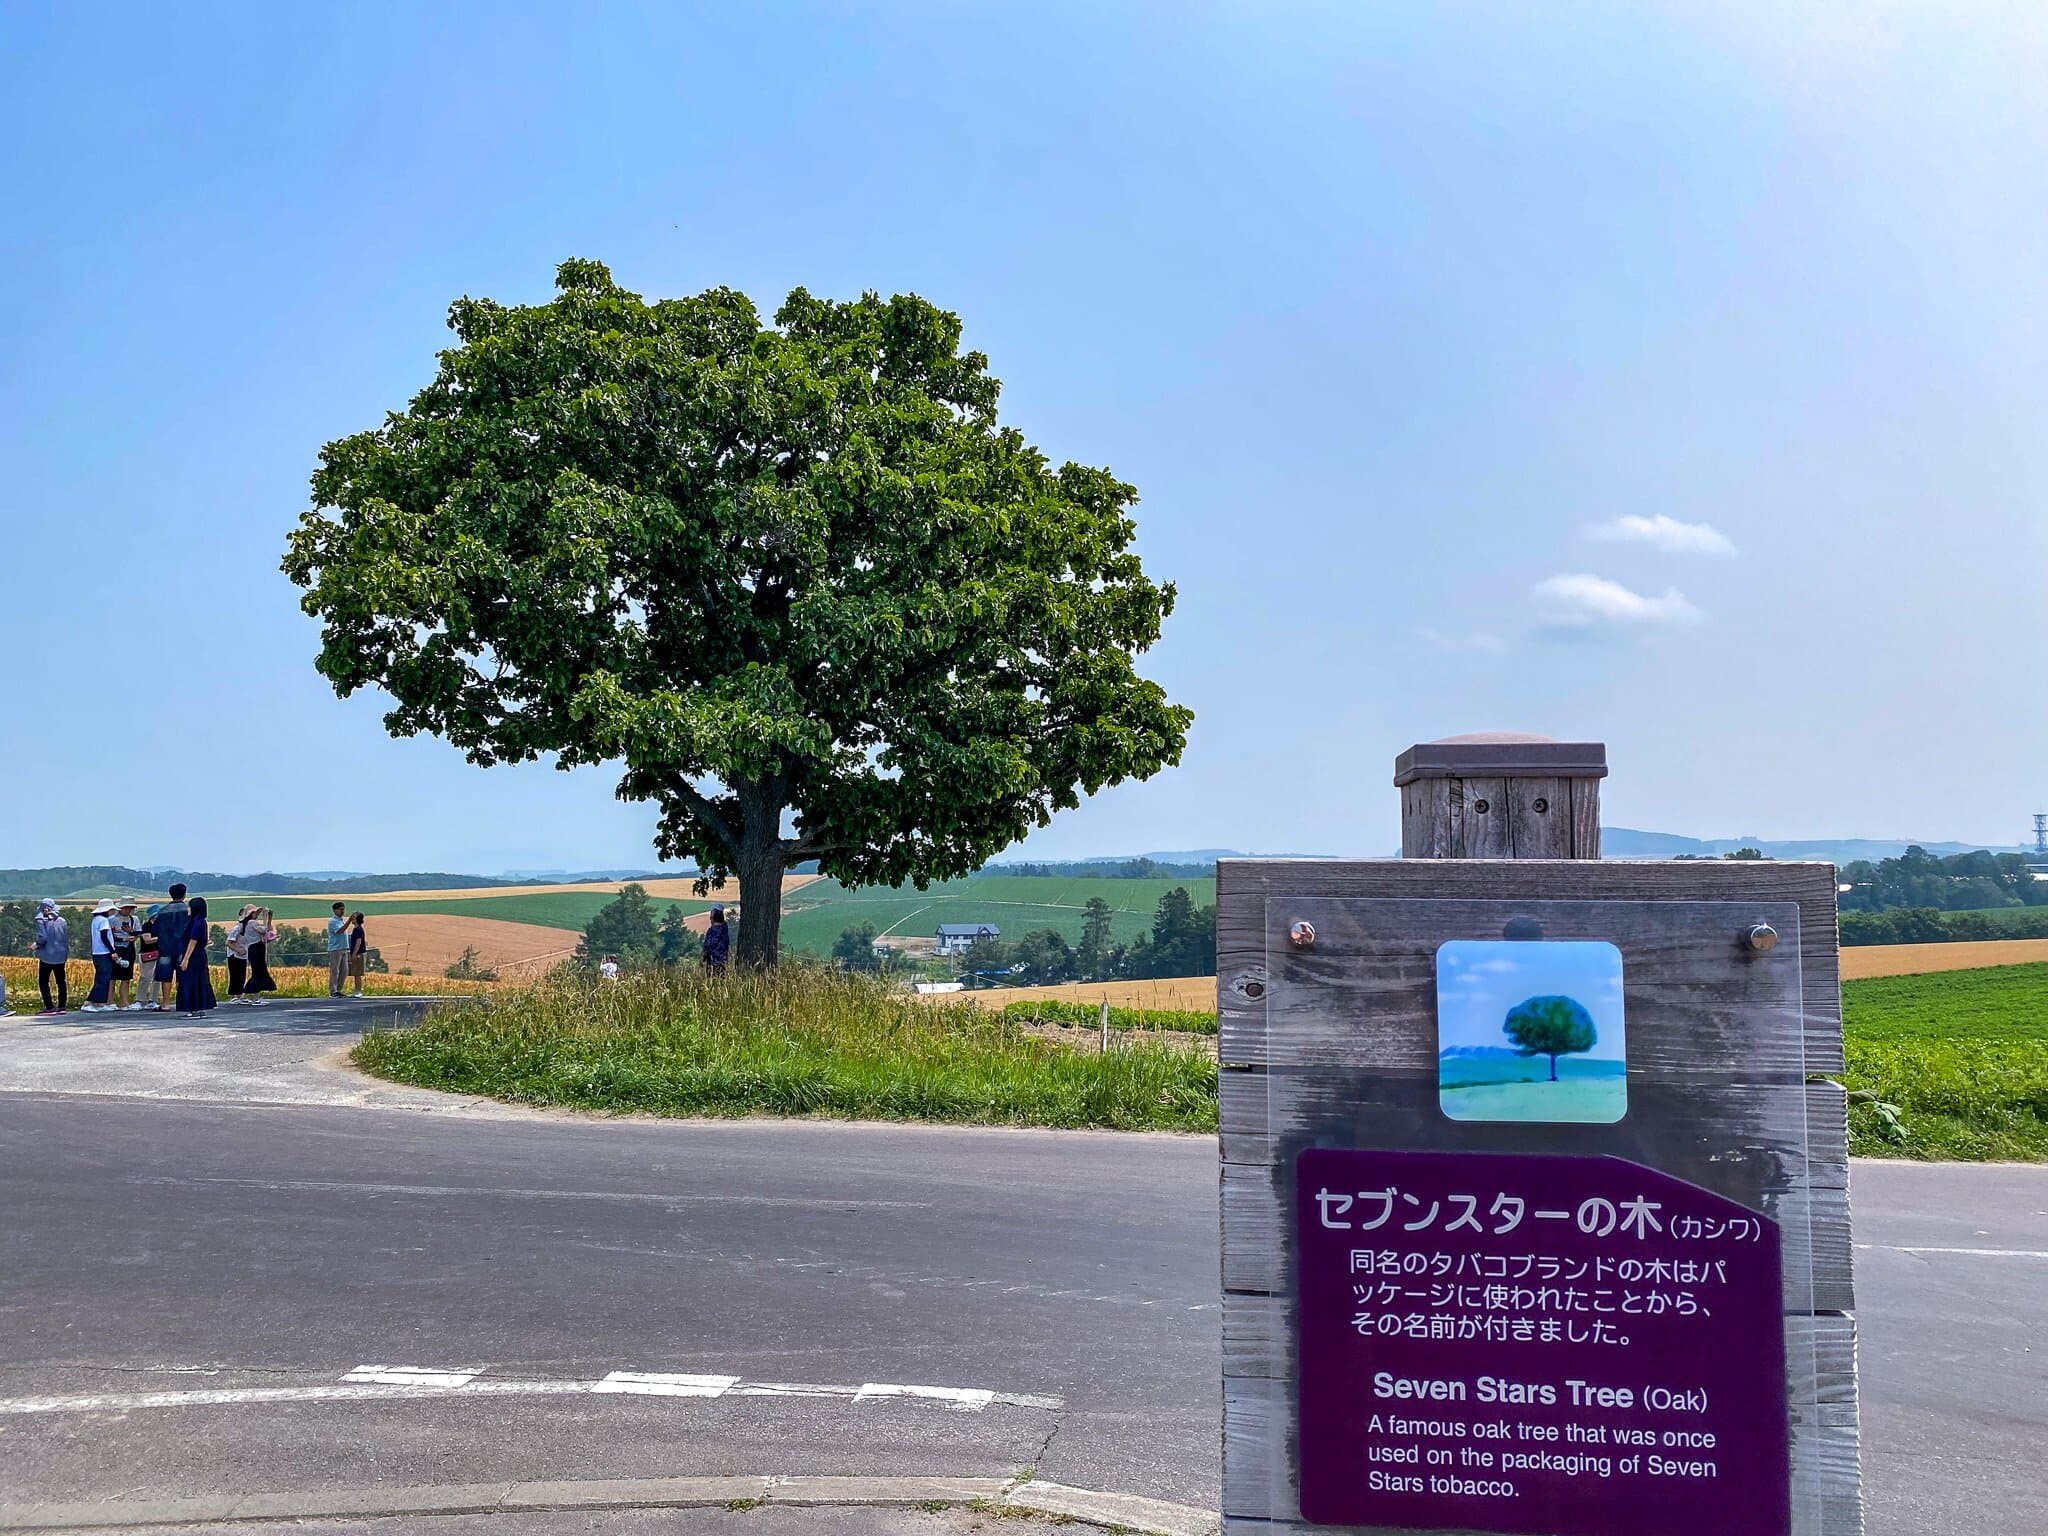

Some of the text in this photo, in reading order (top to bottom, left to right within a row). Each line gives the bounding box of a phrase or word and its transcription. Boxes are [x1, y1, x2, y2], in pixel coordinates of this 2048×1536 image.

[1349, 1248, 1728, 1285] 同名のタバコブランドの木はパ
[1352, 1282, 1712, 1318] ッケージに使われたことから、
[1350, 1311, 1632, 1347] その名前が付きました。
[1373, 1372, 1708, 1414] Seven Stars Tree (Oak)
[1367, 1414, 1716, 1449] A famous oak tree that was once
[1368, 1444, 1717, 1478] used on the packaging of Seven
[1368, 1470, 1520, 1497] Stars tobacco.
